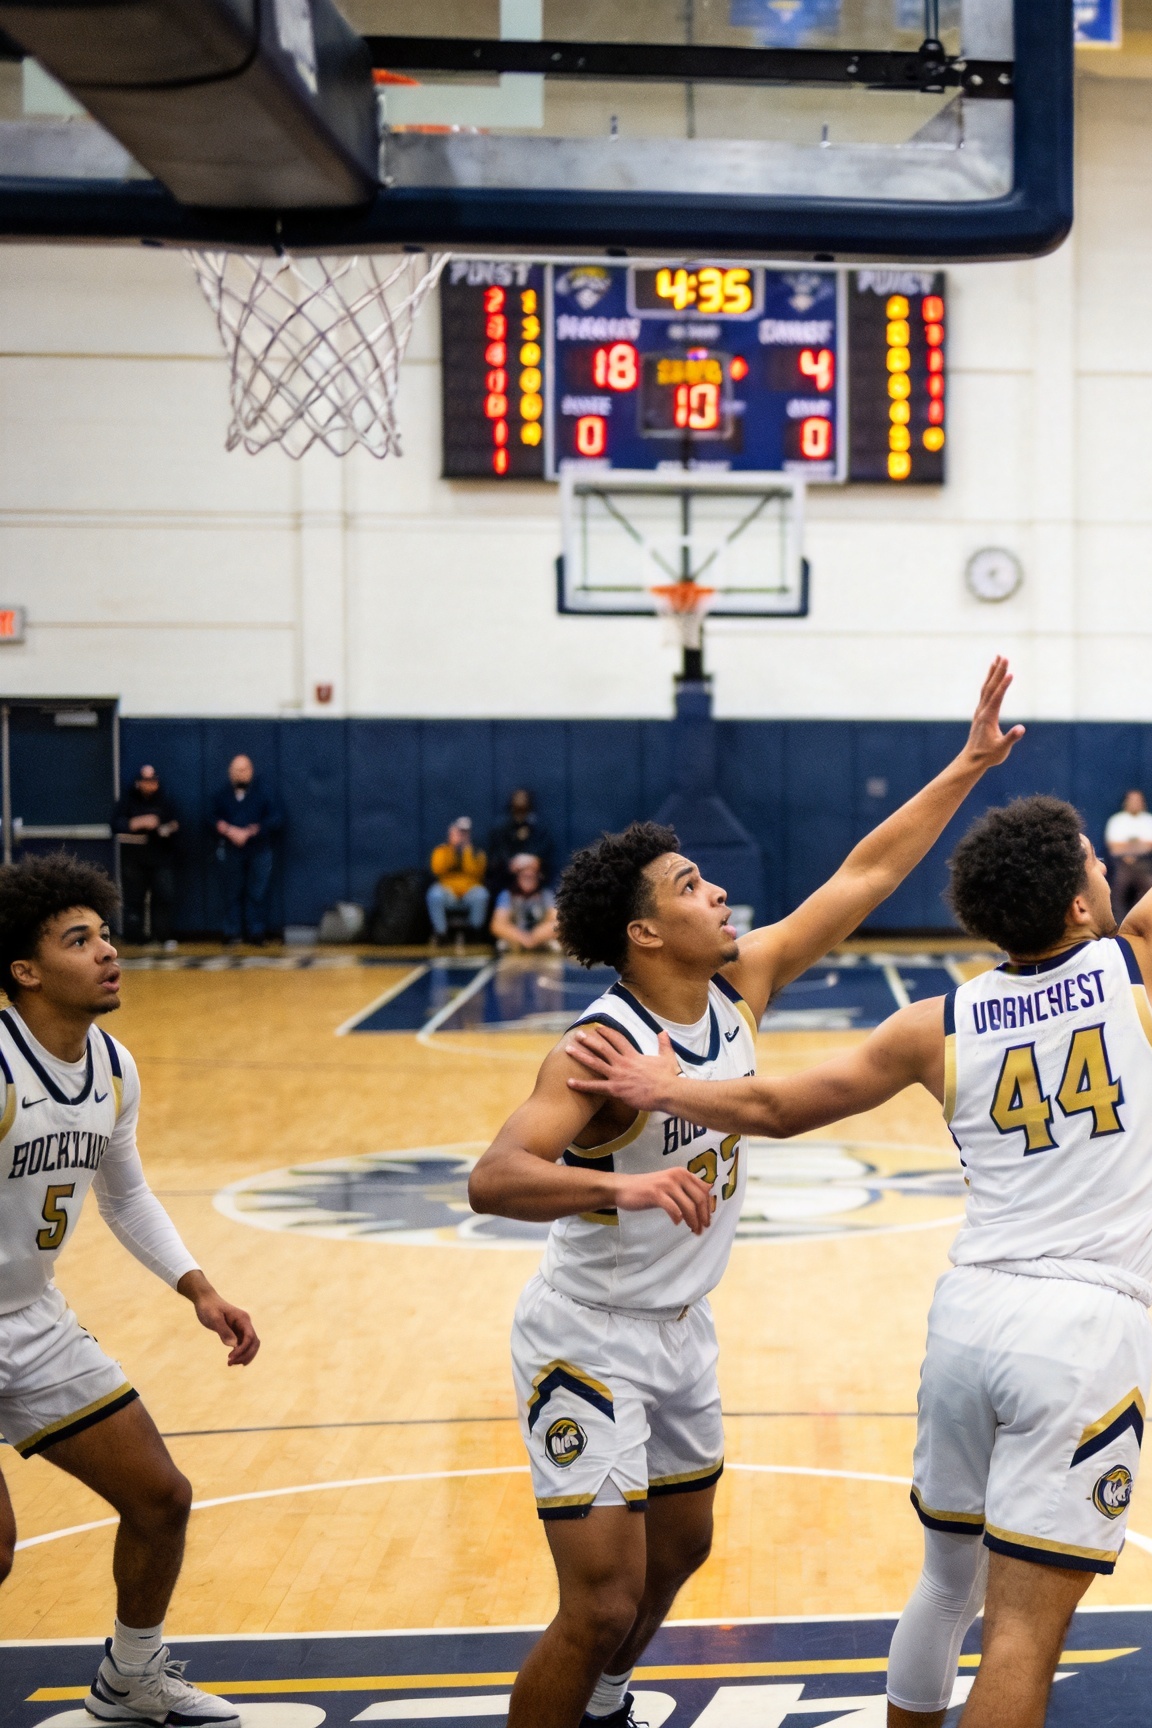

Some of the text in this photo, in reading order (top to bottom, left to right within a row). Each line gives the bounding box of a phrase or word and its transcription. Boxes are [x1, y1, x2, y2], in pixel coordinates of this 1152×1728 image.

[655, 267, 752, 314] 4:35
[594, 342, 639, 392] 18
[799, 348, 834, 393] 4
[576, 415, 606, 457] 0
[801, 416, 831, 460] 0
[990, 1021, 1126, 1157] 44
[36, 1182, 76, 1251] 5
